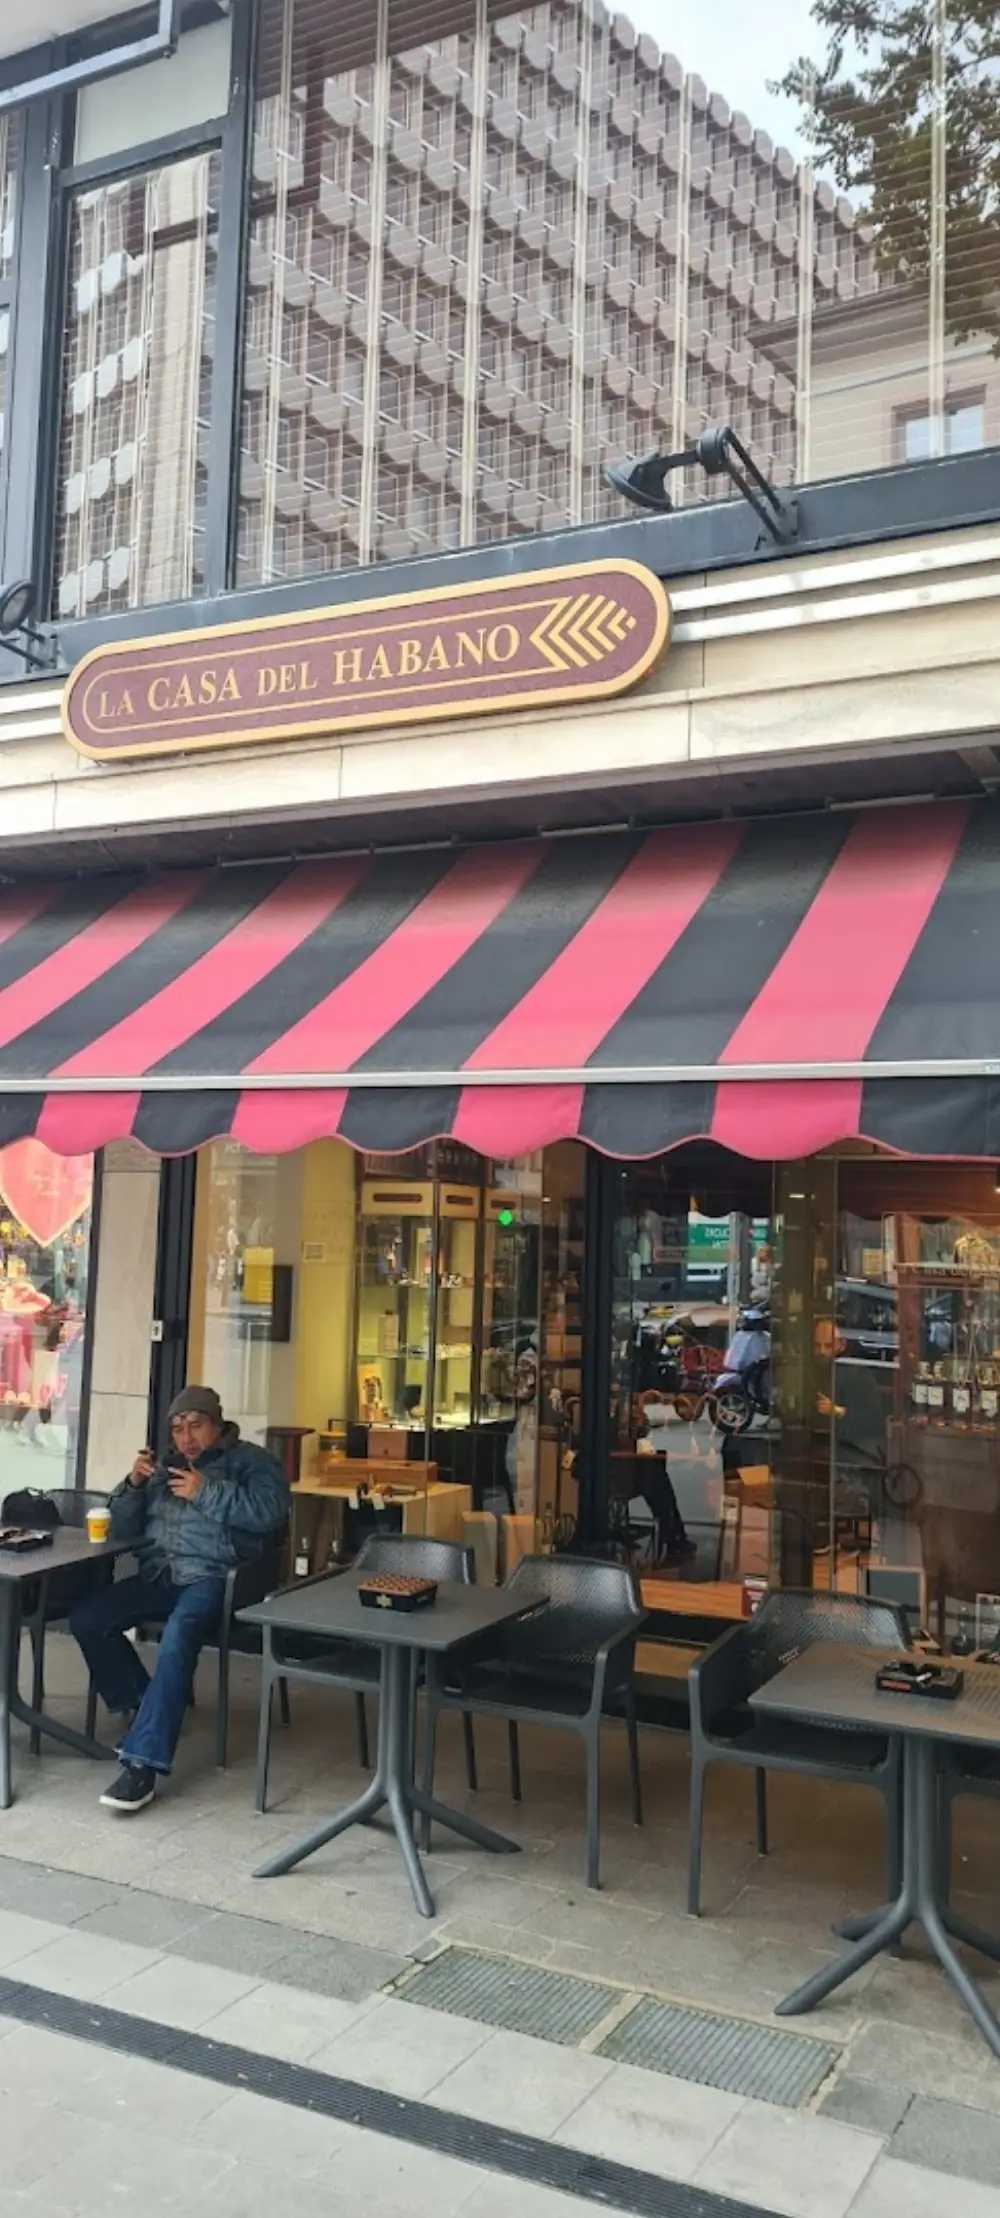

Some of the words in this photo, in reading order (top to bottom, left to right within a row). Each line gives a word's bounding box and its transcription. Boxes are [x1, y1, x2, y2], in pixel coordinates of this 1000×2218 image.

[98, 689, 135, 719] LA
[147, 667, 243, 711] CASA
[257, 661, 319, 696] DEL
[332, 623, 521, 686] HABANO
